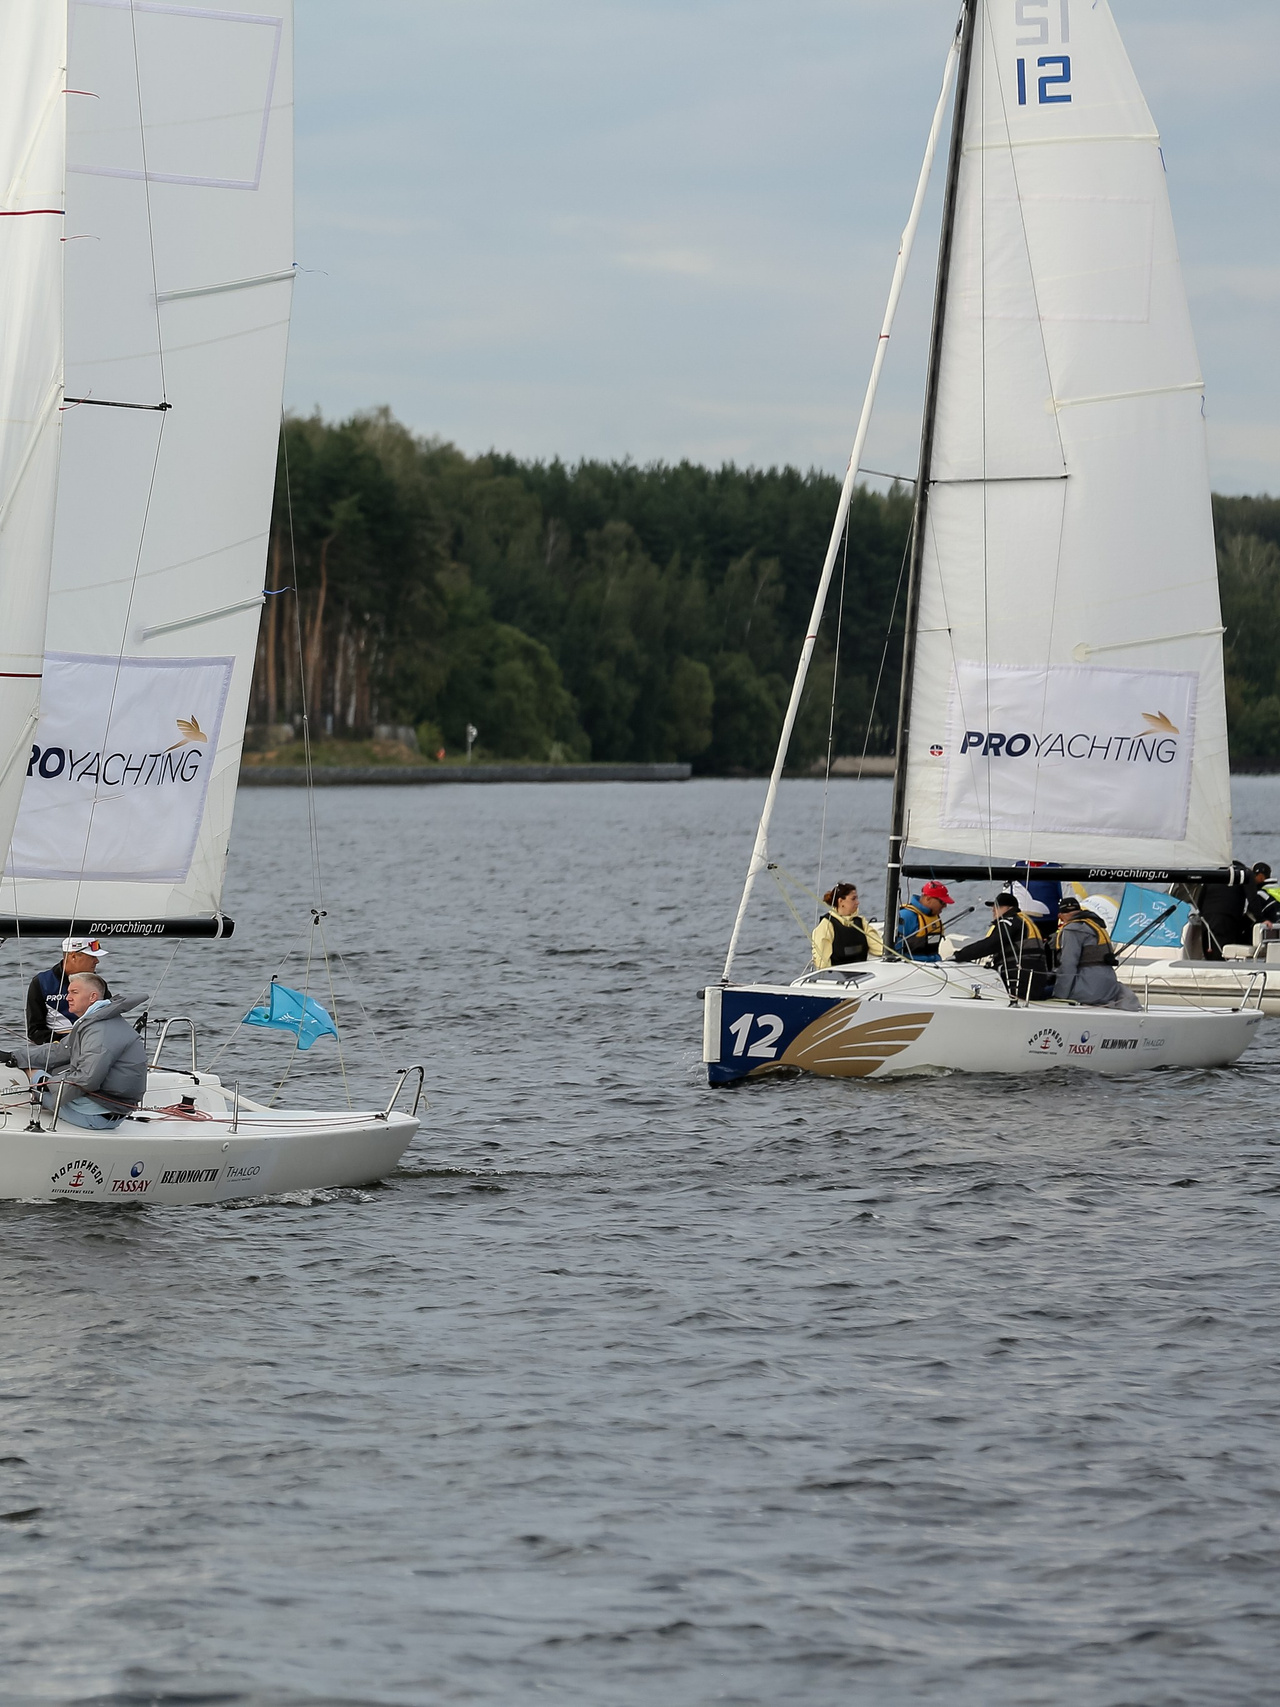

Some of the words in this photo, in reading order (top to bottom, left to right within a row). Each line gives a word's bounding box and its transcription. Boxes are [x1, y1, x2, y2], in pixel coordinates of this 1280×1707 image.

[1016, 55, 1072, 106] 12
[959, 730, 1178, 764] PROYACHTING
[26, 743, 203, 786] ROYACHTING
[1088, 869, 1169, 881] pro-yachting.ru
[88, 921, 165, 936] pro-yachting.ru
[728, 1013, 784, 1058] 12
[1068, 1044, 1096, 1055] TASSAY
[50, 1159, 104, 1185] МОРПРИБОР
[160, 1168, 220, 1185] ВЕДОМОСТИ
[226, 1165, 261, 1178] THALGO
[111, 1179, 152, 1193] TASSAY
